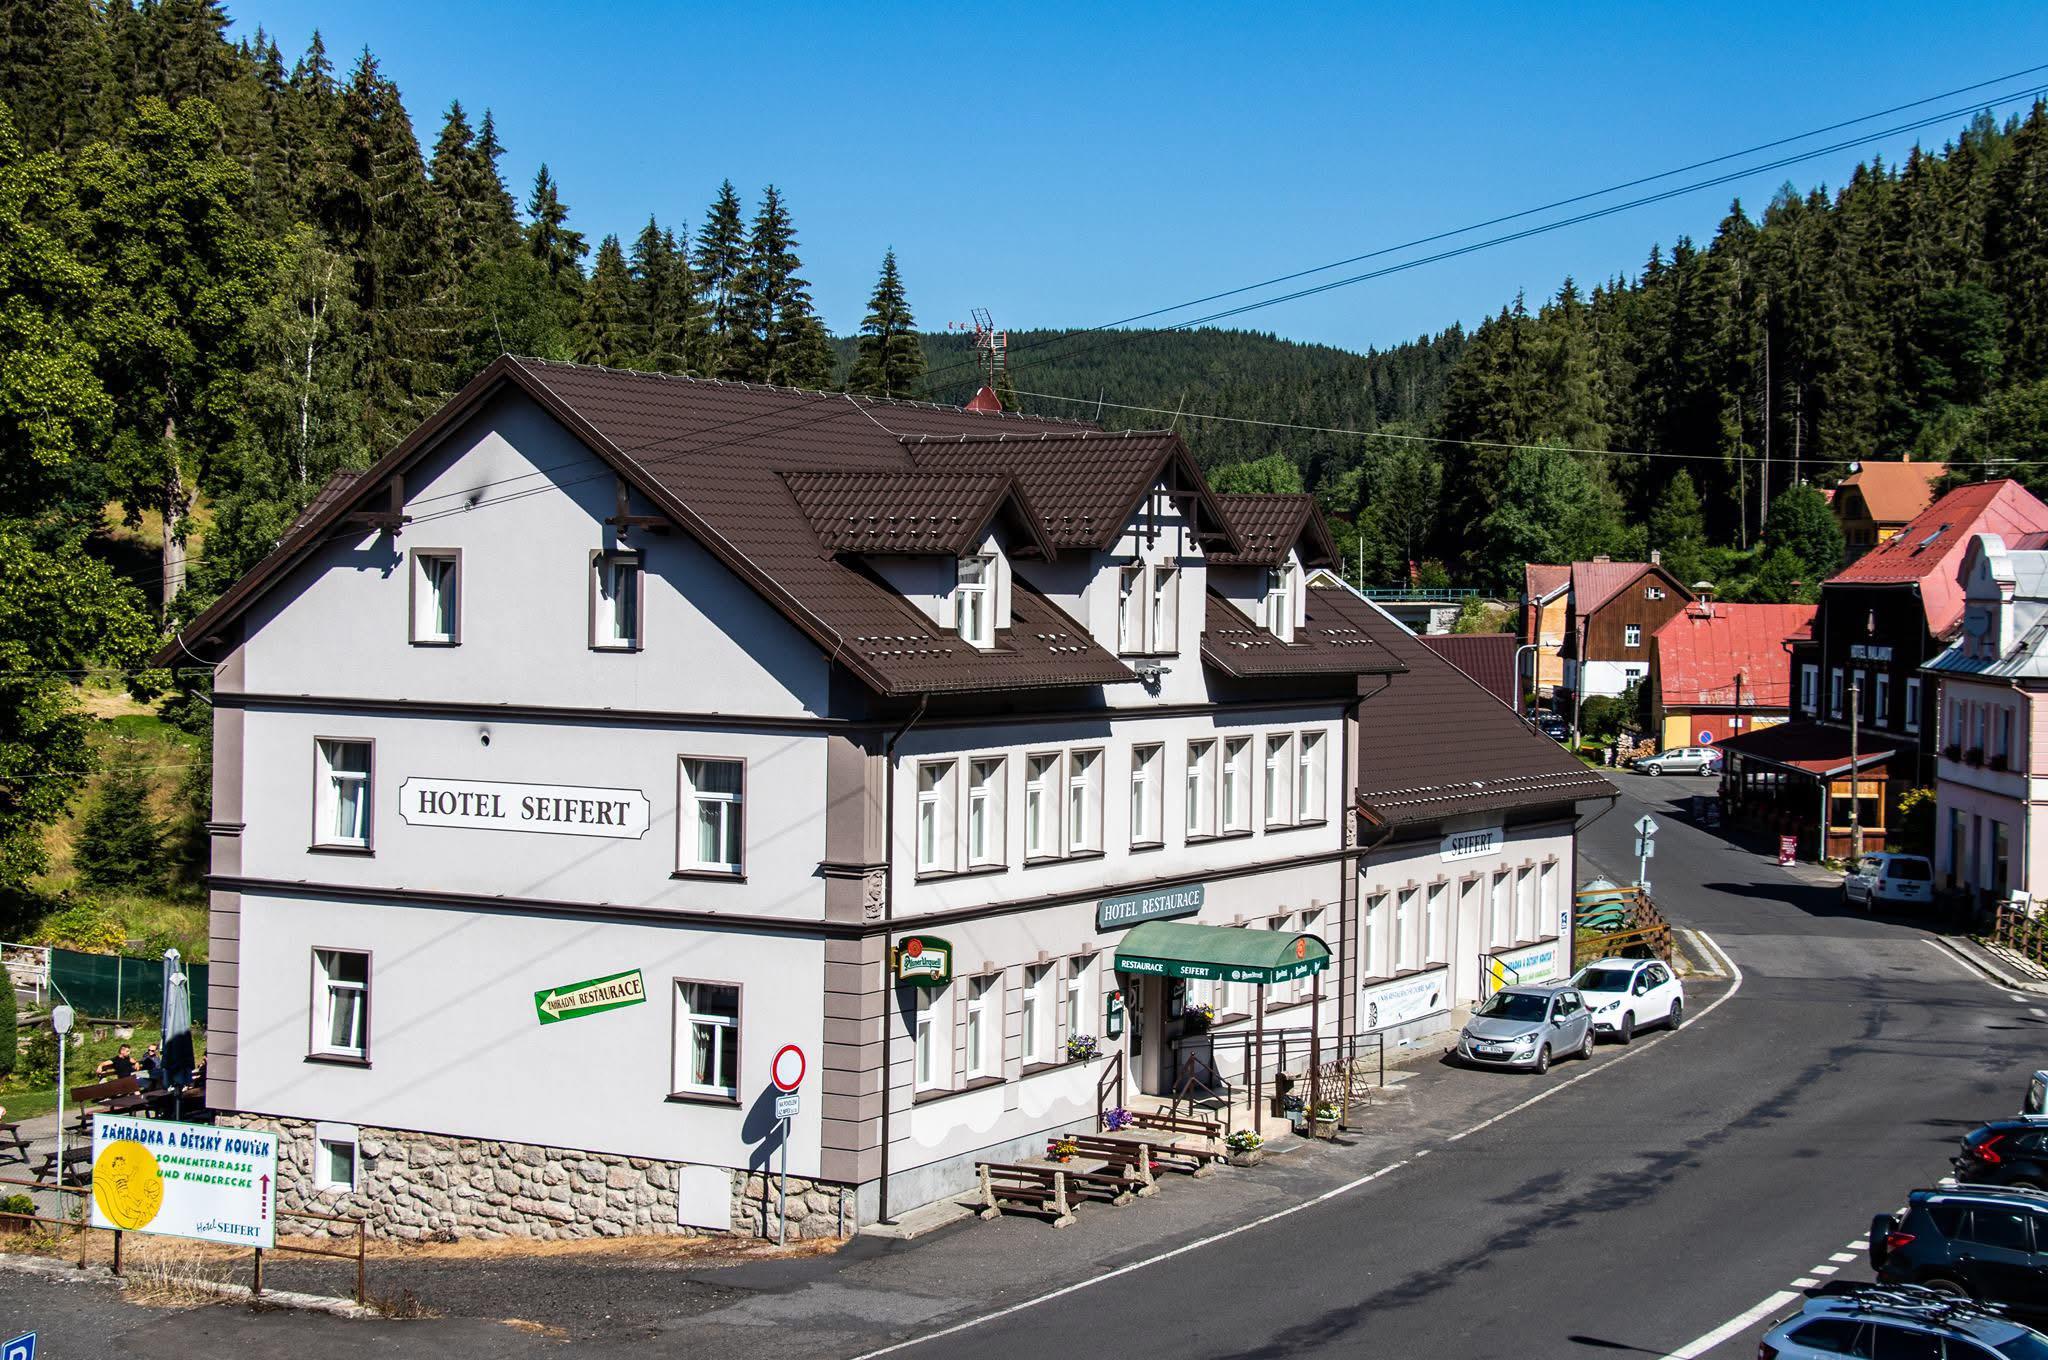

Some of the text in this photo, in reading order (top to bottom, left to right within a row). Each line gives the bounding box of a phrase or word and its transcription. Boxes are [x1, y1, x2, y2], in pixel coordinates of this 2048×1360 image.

[419, 790, 631, 826] HOTEL SEIFERT
[1452, 832, 1493, 857] SEIFERT
[1104, 890, 1200, 921] HOTEL RESTAURACE
[1121, 960, 1210, 976] RESTAURACE SEIFERT
[579, 979, 642, 1004] RESTAURACE
[168, 1132, 176, 1146] A
[180, 1128, 222, 1152] DĚTSKÝ
[156, 1154, 253, 1173] SONNENTERRASSE
[156, 1169, 253, 1188] UND KINDERECKE
[196, 1219, 261, 1237] Hotel SEIFERT
